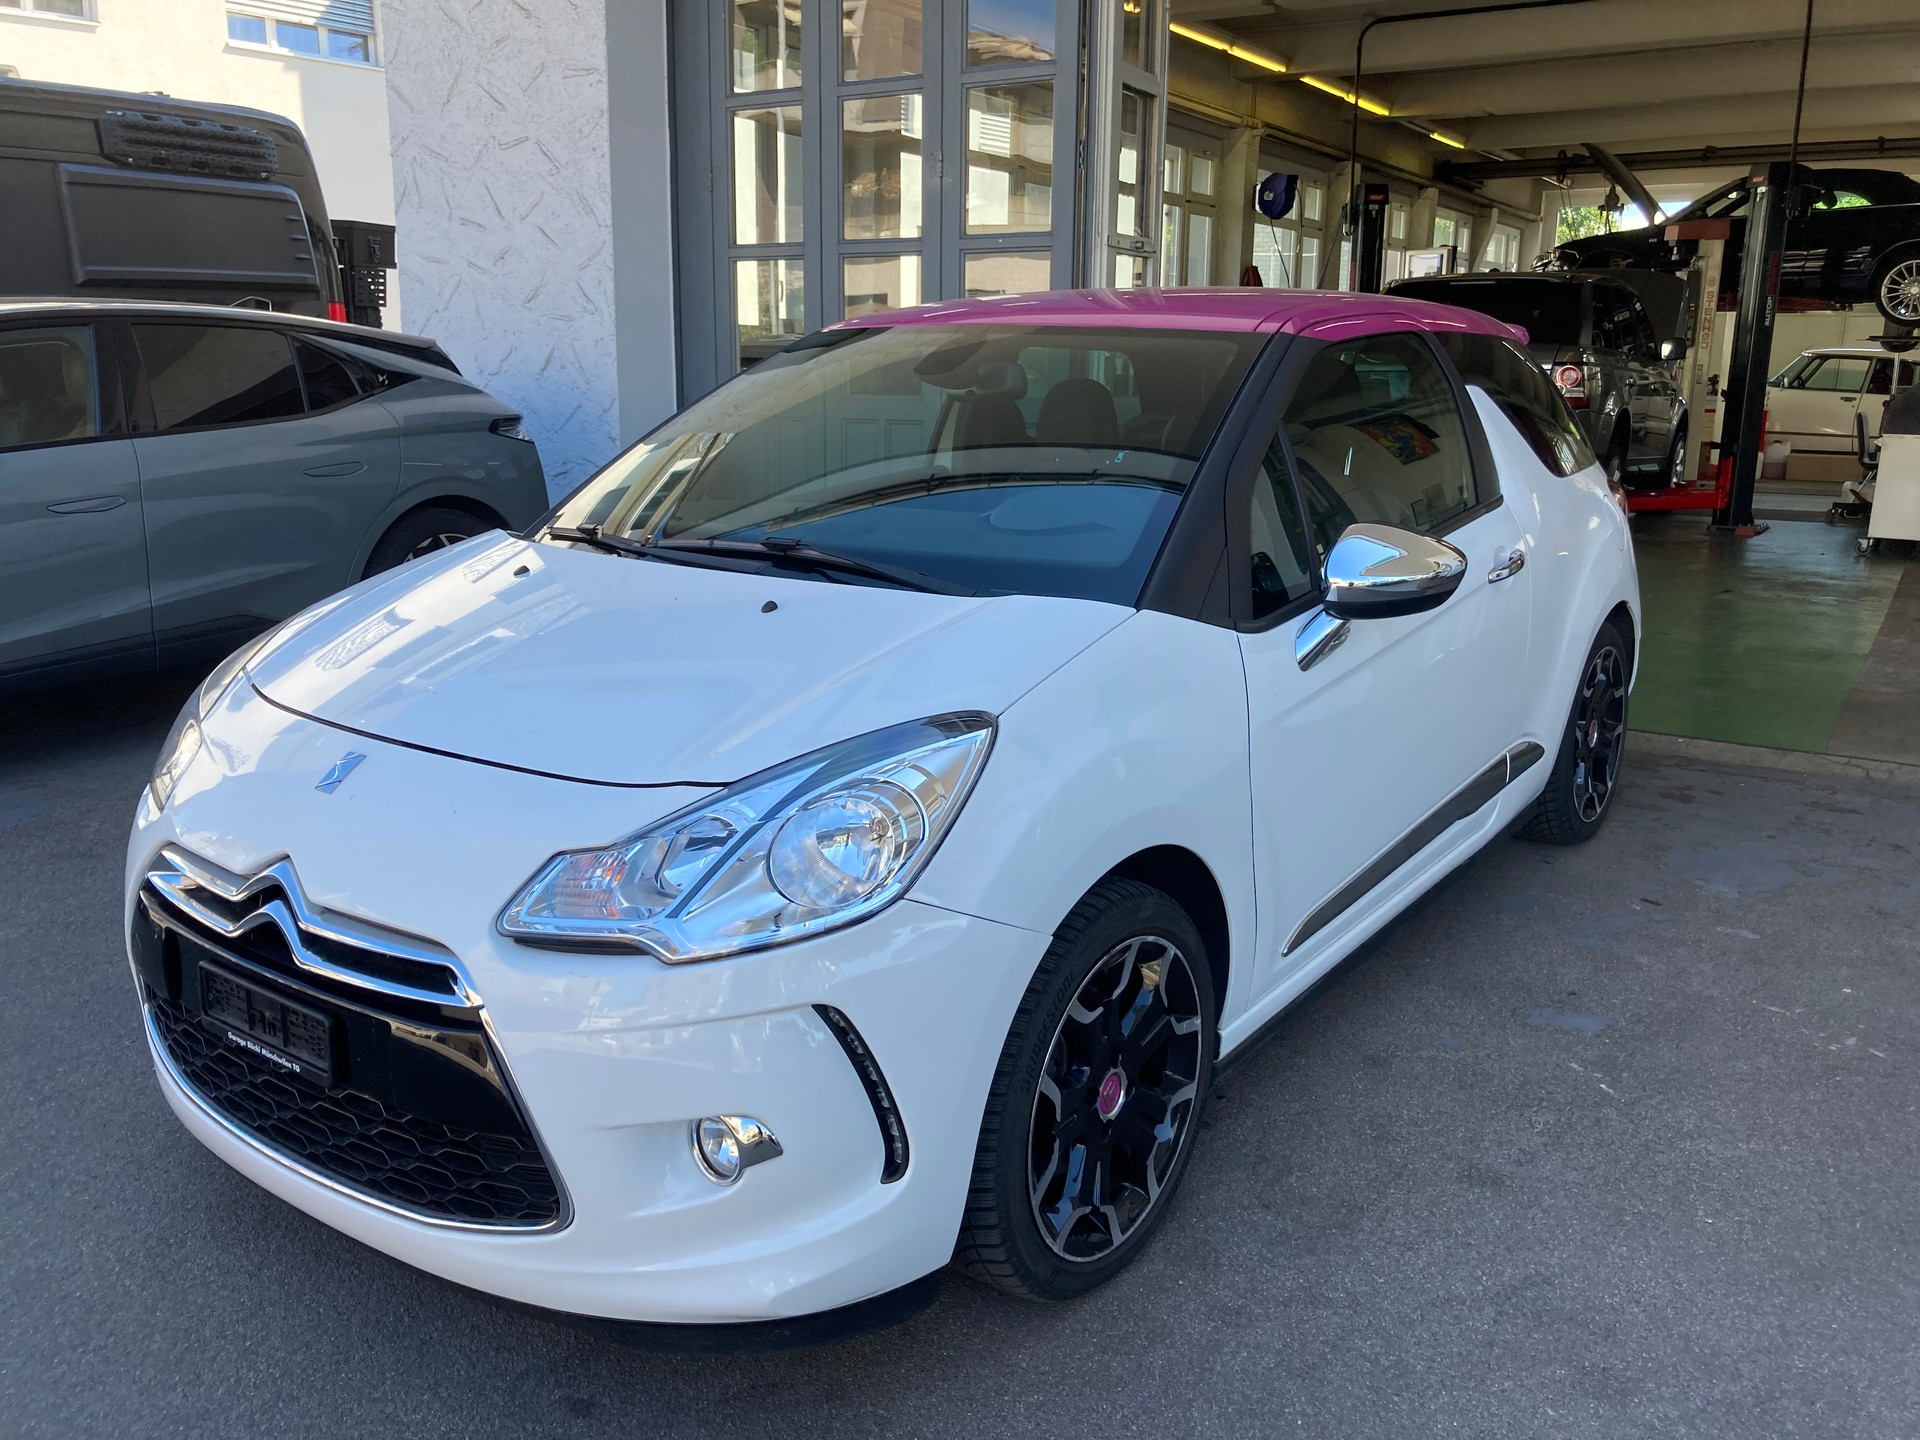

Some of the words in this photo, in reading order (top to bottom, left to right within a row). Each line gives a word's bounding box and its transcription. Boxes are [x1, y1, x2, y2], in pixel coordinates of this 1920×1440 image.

[1764, 296, 1773, 327] AUTOP
[227, 1031, 247, 1047] Garage
[1020, 966, 1078, 1097] BRIDGESTONE
